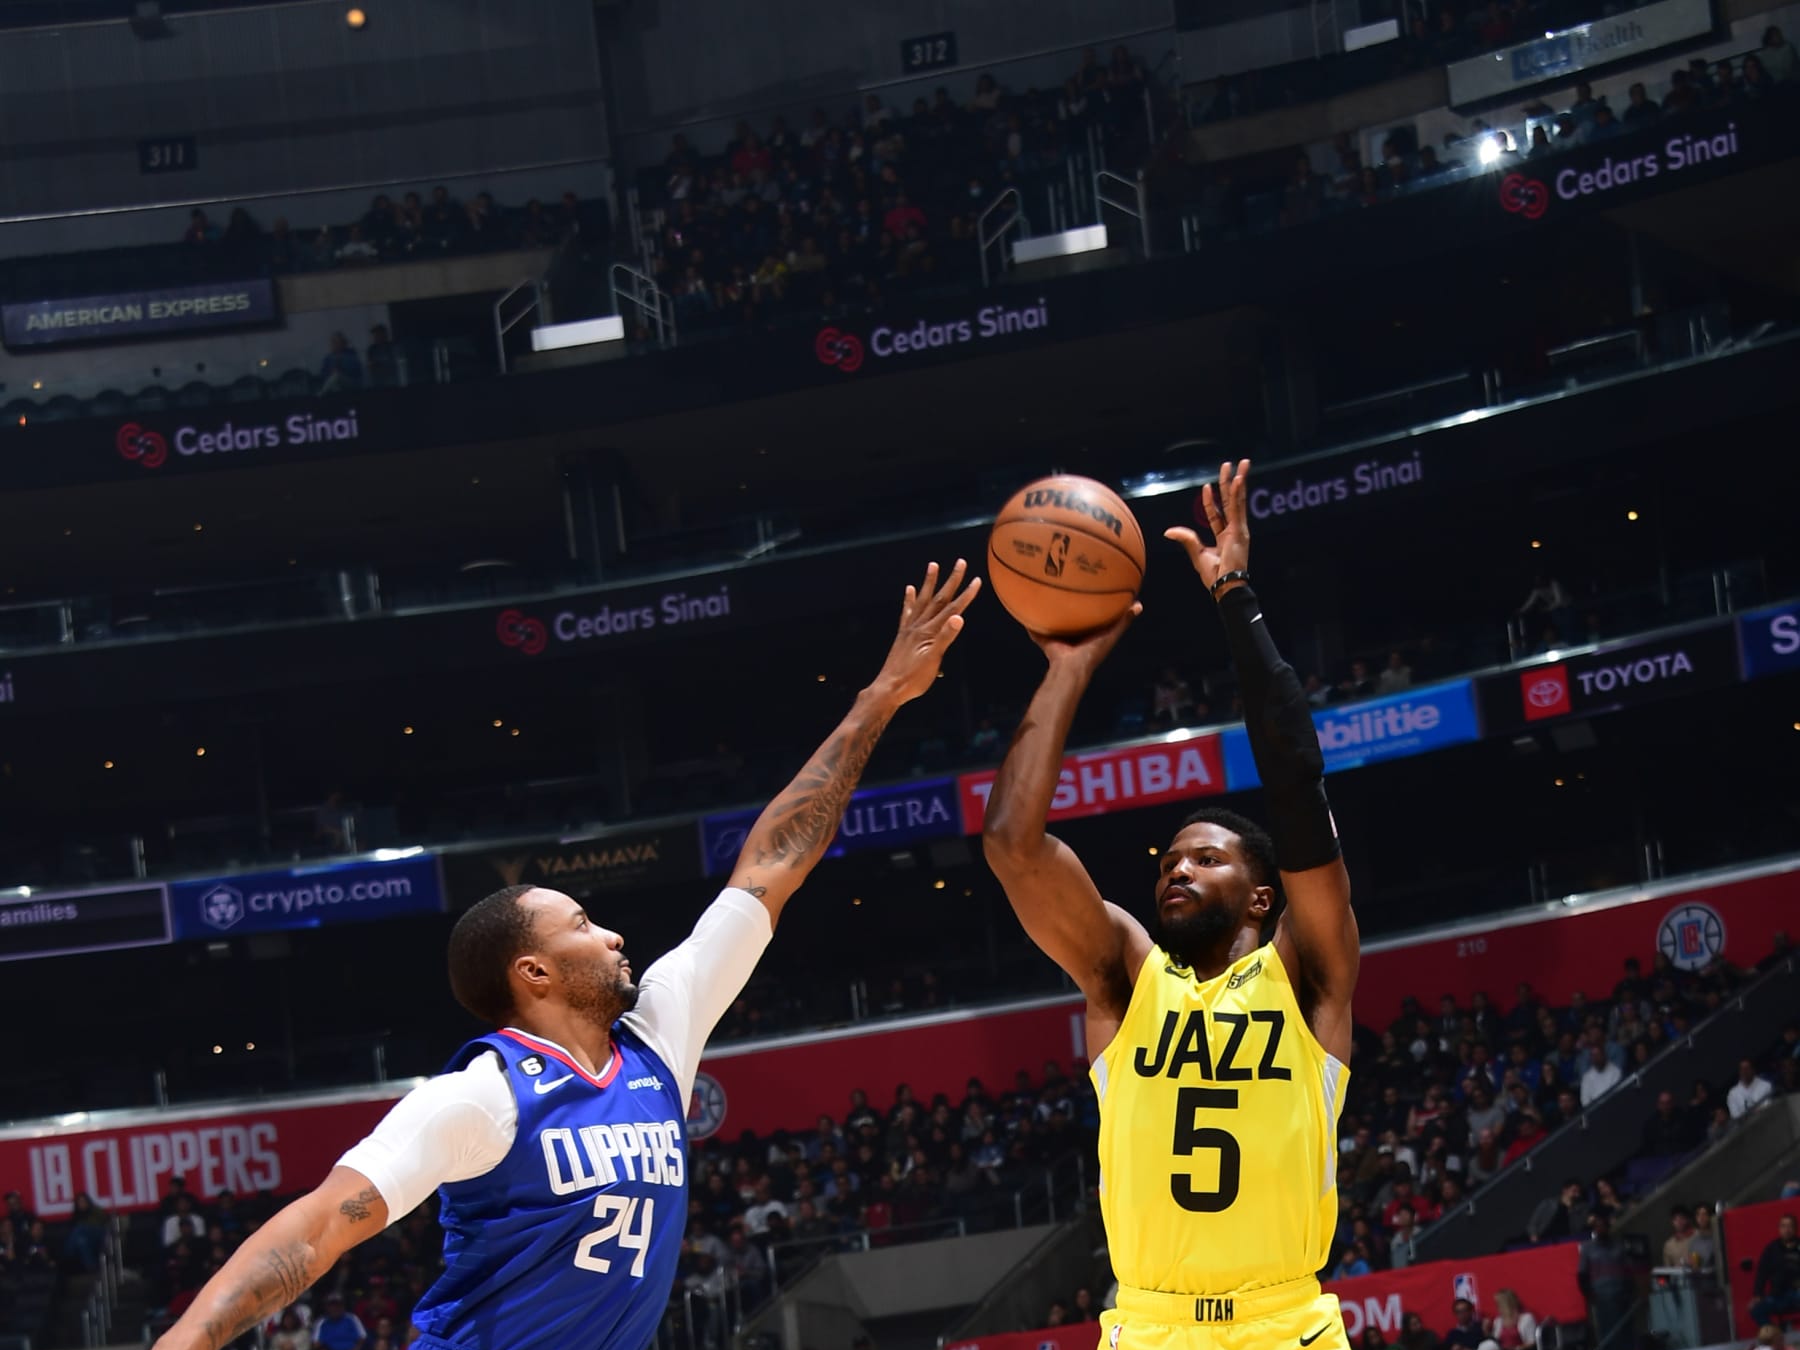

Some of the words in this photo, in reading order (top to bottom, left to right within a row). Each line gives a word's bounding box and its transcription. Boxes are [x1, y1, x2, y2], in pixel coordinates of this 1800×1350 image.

[1556, 152, 1659, 200] Cedars
[1665, 122, 1738, 171] Sinai
[26, 304, 143, 331] AMERICAN
[149, 294, 250, 320] EXPRESS
[871, 319, 972, 357] Cedars
[976, 297, 1048, 338] Sinai
[175, 421, 280, 456] Cedars
[286, 409, 359, 444] Sinai
[1250, 477, 1347, 520] Cedars
[1353, 451, 1423, 495] Sinai
[554, 605, 655, 641] Cedars
[660, 585, 731, 624] Sinai
[1577, 652, 1693, 695] TOYOTA
[1316, 703, 1440, 750] bilitie
[971, 748, 1211, 811] TSHIBA
[841, 797, 949, 836] ULTRA
[251, 877, 412, 914] crypto.com
[520, 1057, 543, 1076] 6
[1134, 1010, 1292, 1081] JAZZ
[30, 1144, 74, 1217] LA
[82, 1122, 281, 1208] CLIPPERS
[540, 1120, 684, 1196] CLIPPERS
[1170, 1087, 1241, 1213] 5
[573, 1195, 655, 1278] 24
[1195, 1297, 1234, 1322] UTAH
